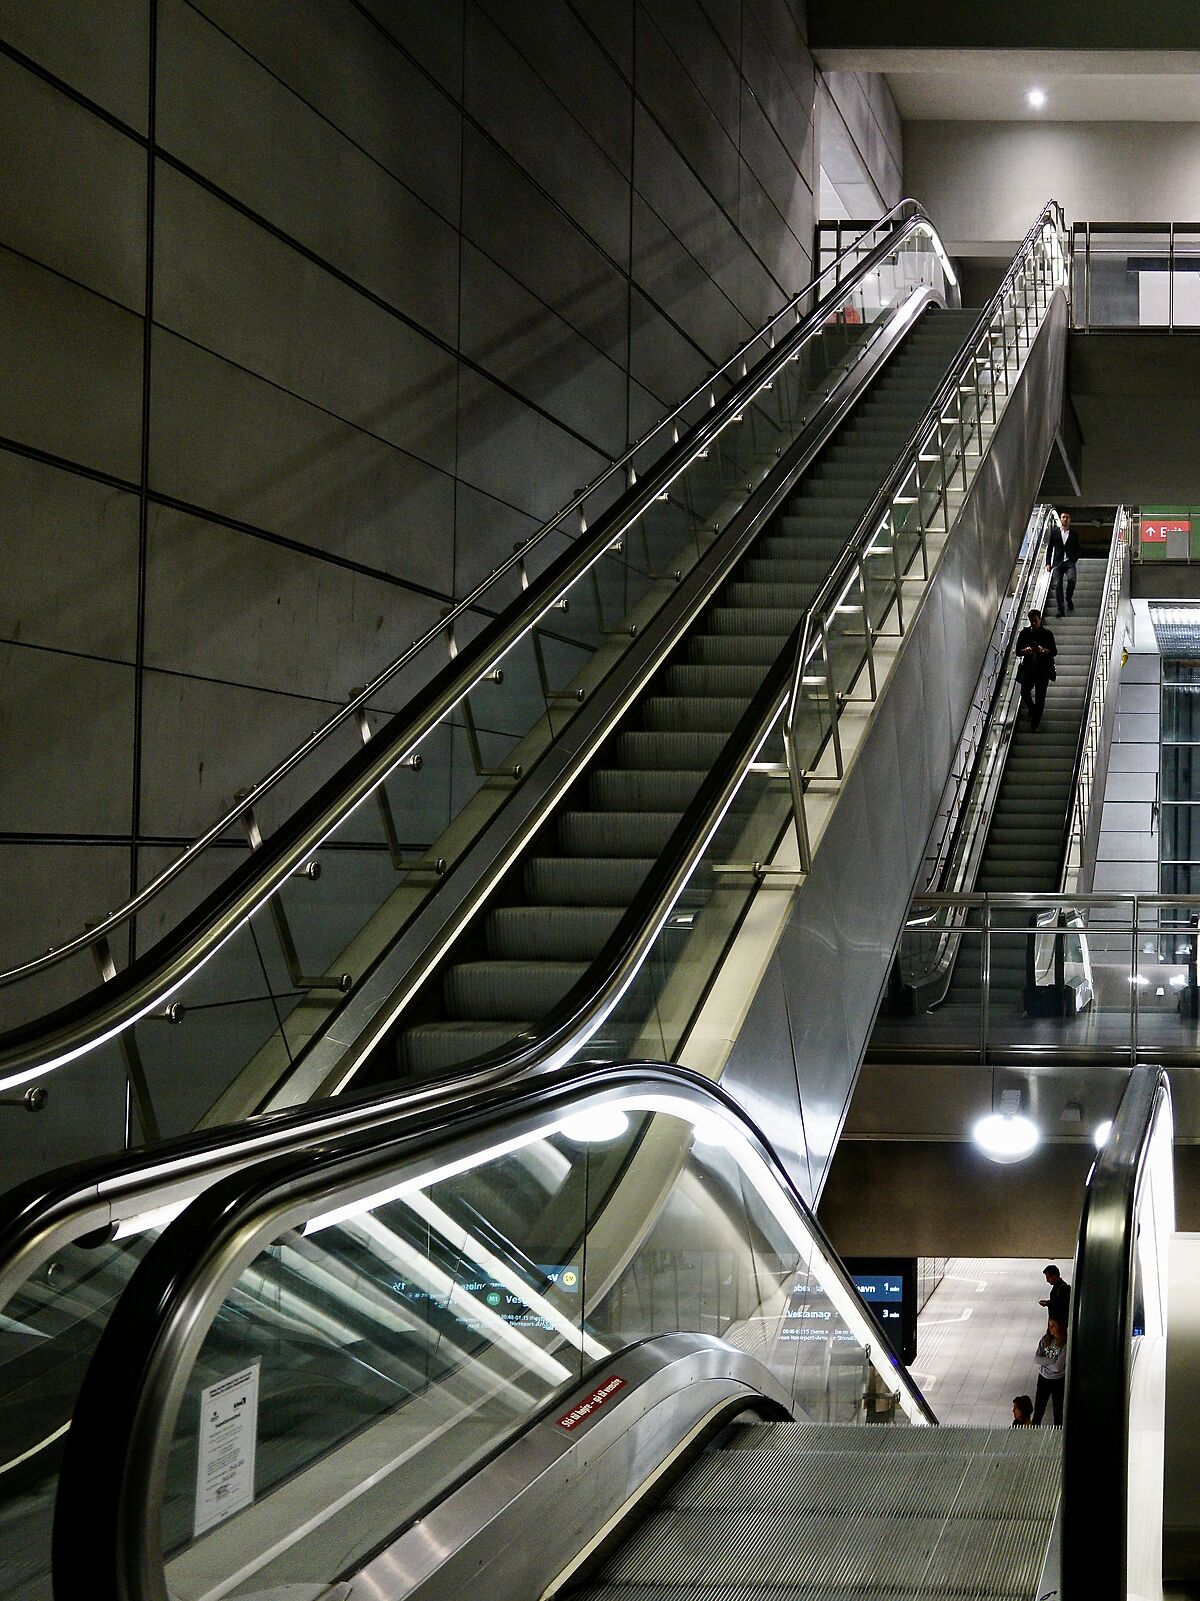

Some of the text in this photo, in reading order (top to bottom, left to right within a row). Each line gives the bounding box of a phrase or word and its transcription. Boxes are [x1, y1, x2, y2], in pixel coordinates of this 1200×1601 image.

[882, 1310, 889, 1318] 3
[561, 1417, 574, 1428] Stå
[570, 1411, 581, 1420] til
[578, 1404, 592, 1415] højre
[592, 1394, 602, 1404] gå
[598, 1389, 607, 1398] til
[604, 1378, 622, 1392] venstre
